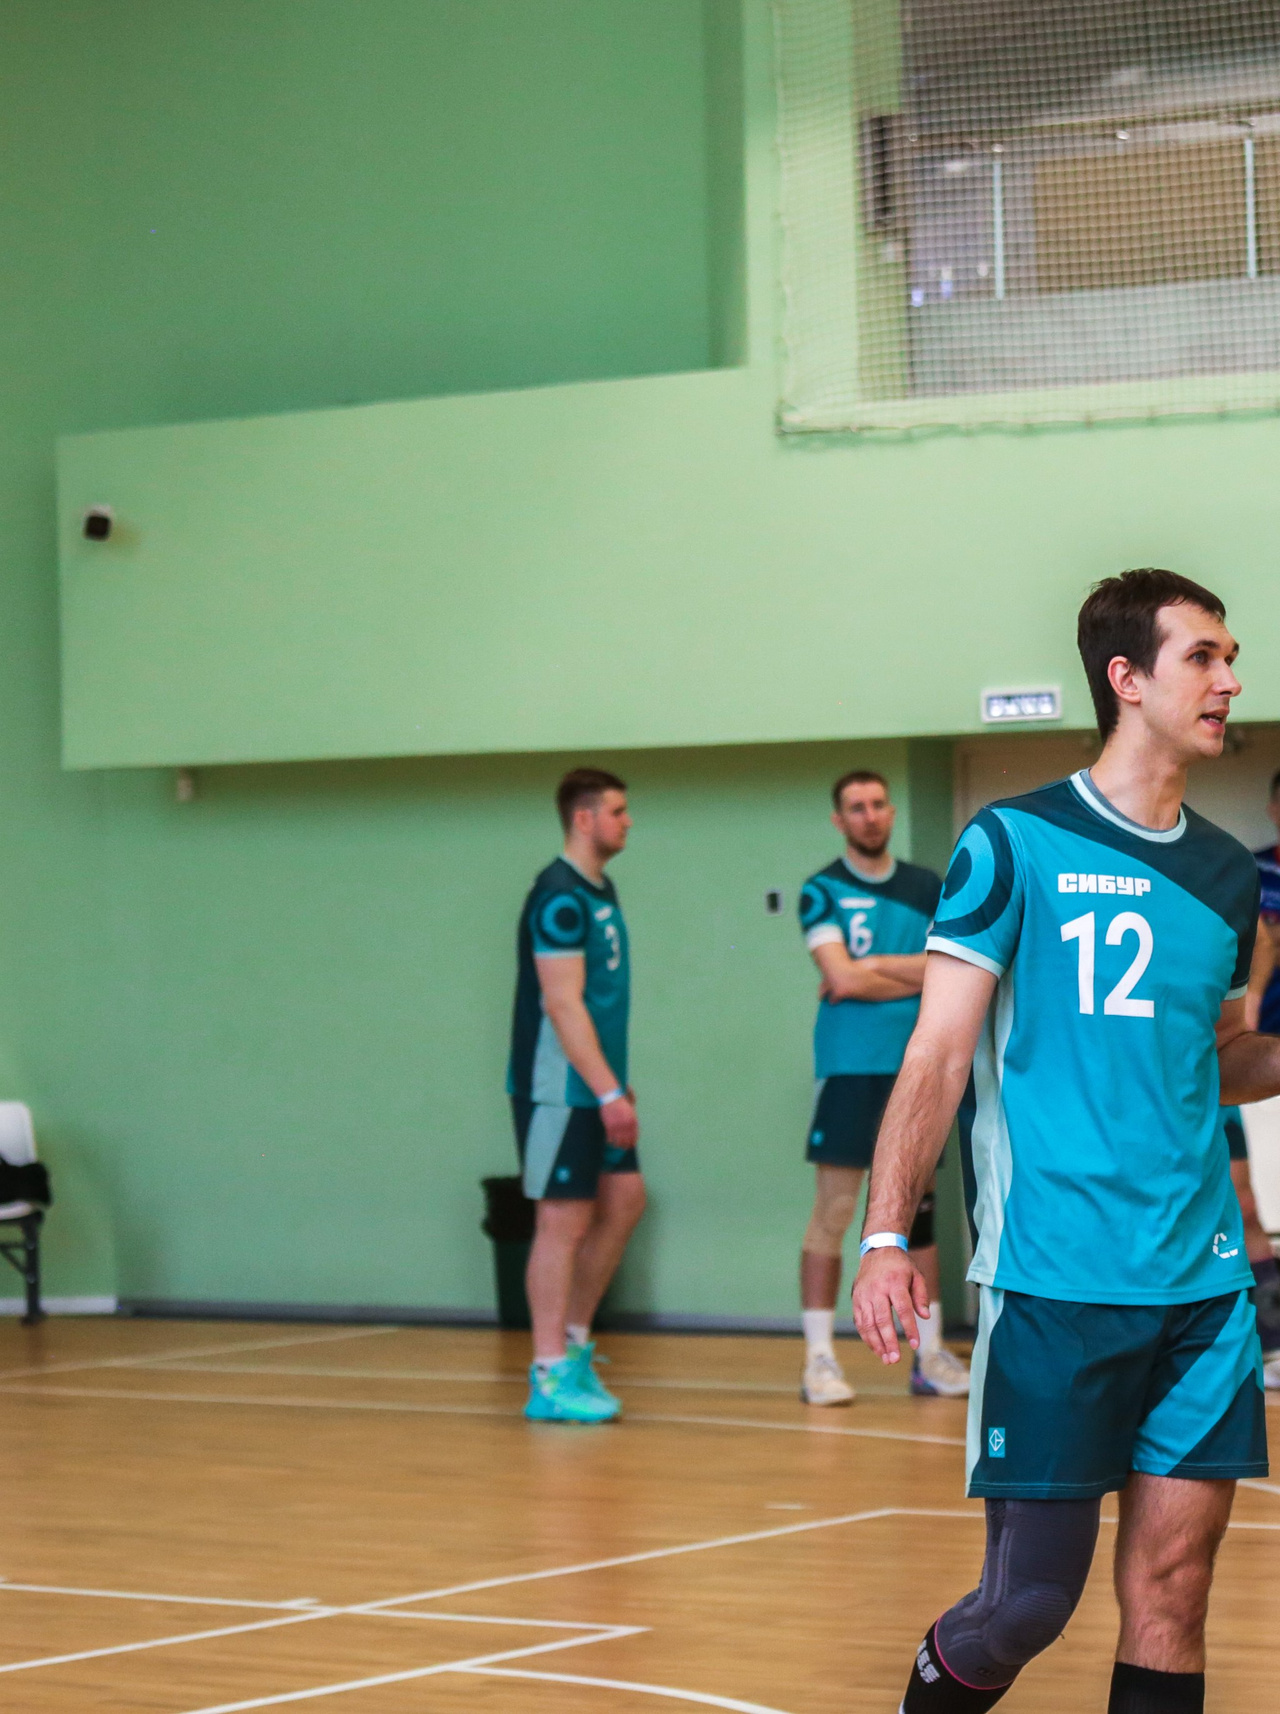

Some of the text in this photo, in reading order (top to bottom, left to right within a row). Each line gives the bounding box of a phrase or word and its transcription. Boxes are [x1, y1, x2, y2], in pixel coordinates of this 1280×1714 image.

[1058, 873, 1151, 896] СИБУР
[605, 925, 620, 971] 3
[849, 911, 873, 957] 6
[1060, 911, 1155, 1018] 12
